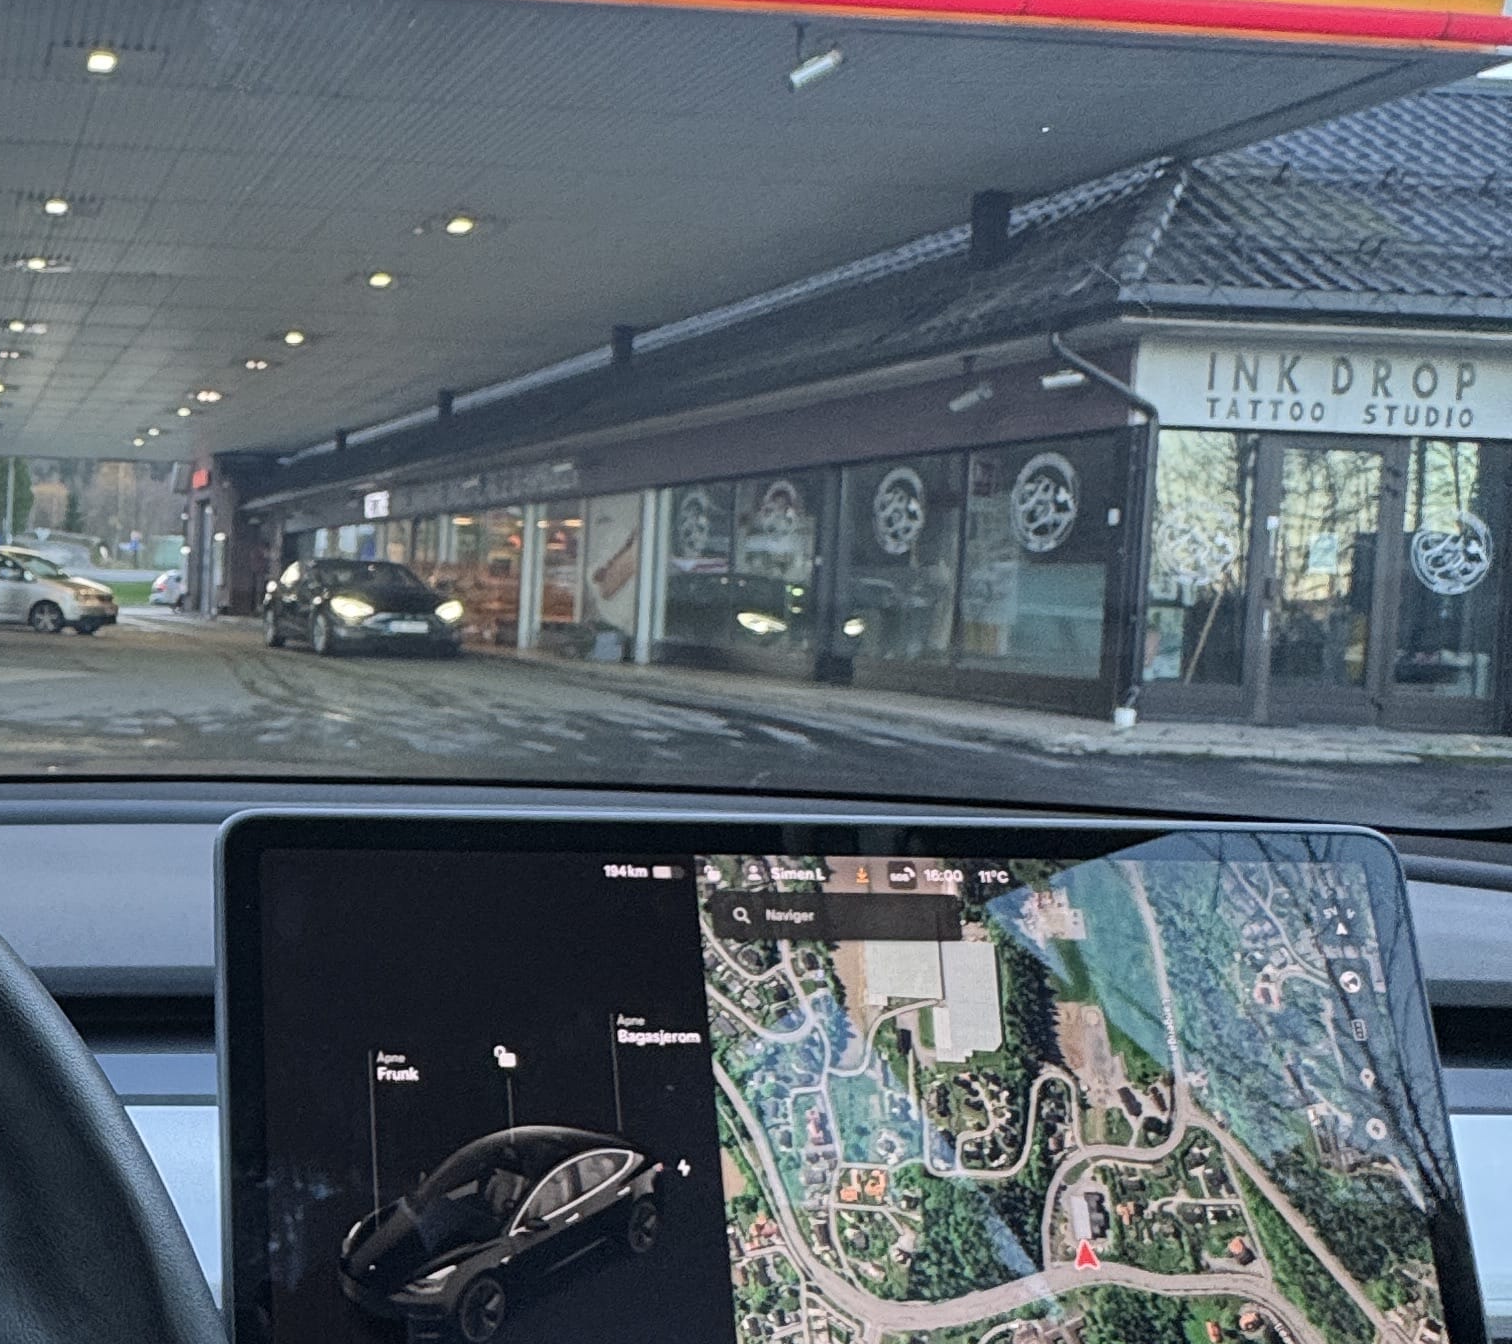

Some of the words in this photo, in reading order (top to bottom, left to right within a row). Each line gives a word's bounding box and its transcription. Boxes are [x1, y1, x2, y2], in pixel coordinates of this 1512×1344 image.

[1207, 352, 1301, 393] INK
[1331, 356, 1476, 400] DROP
[1207, 397, 1325, 422] TATTOO
[1363, 405, 1474, 428] STUDIO
[627, 864, 648, 877] km
[770, 867, 815, 881] Simen
[815, 867, 826, 881] L
[765, 908, 815, 924] Naviger
[617, 1029, 701, 1046] Bagasjerom
[377, 1066, 419, 1081] Frunk
